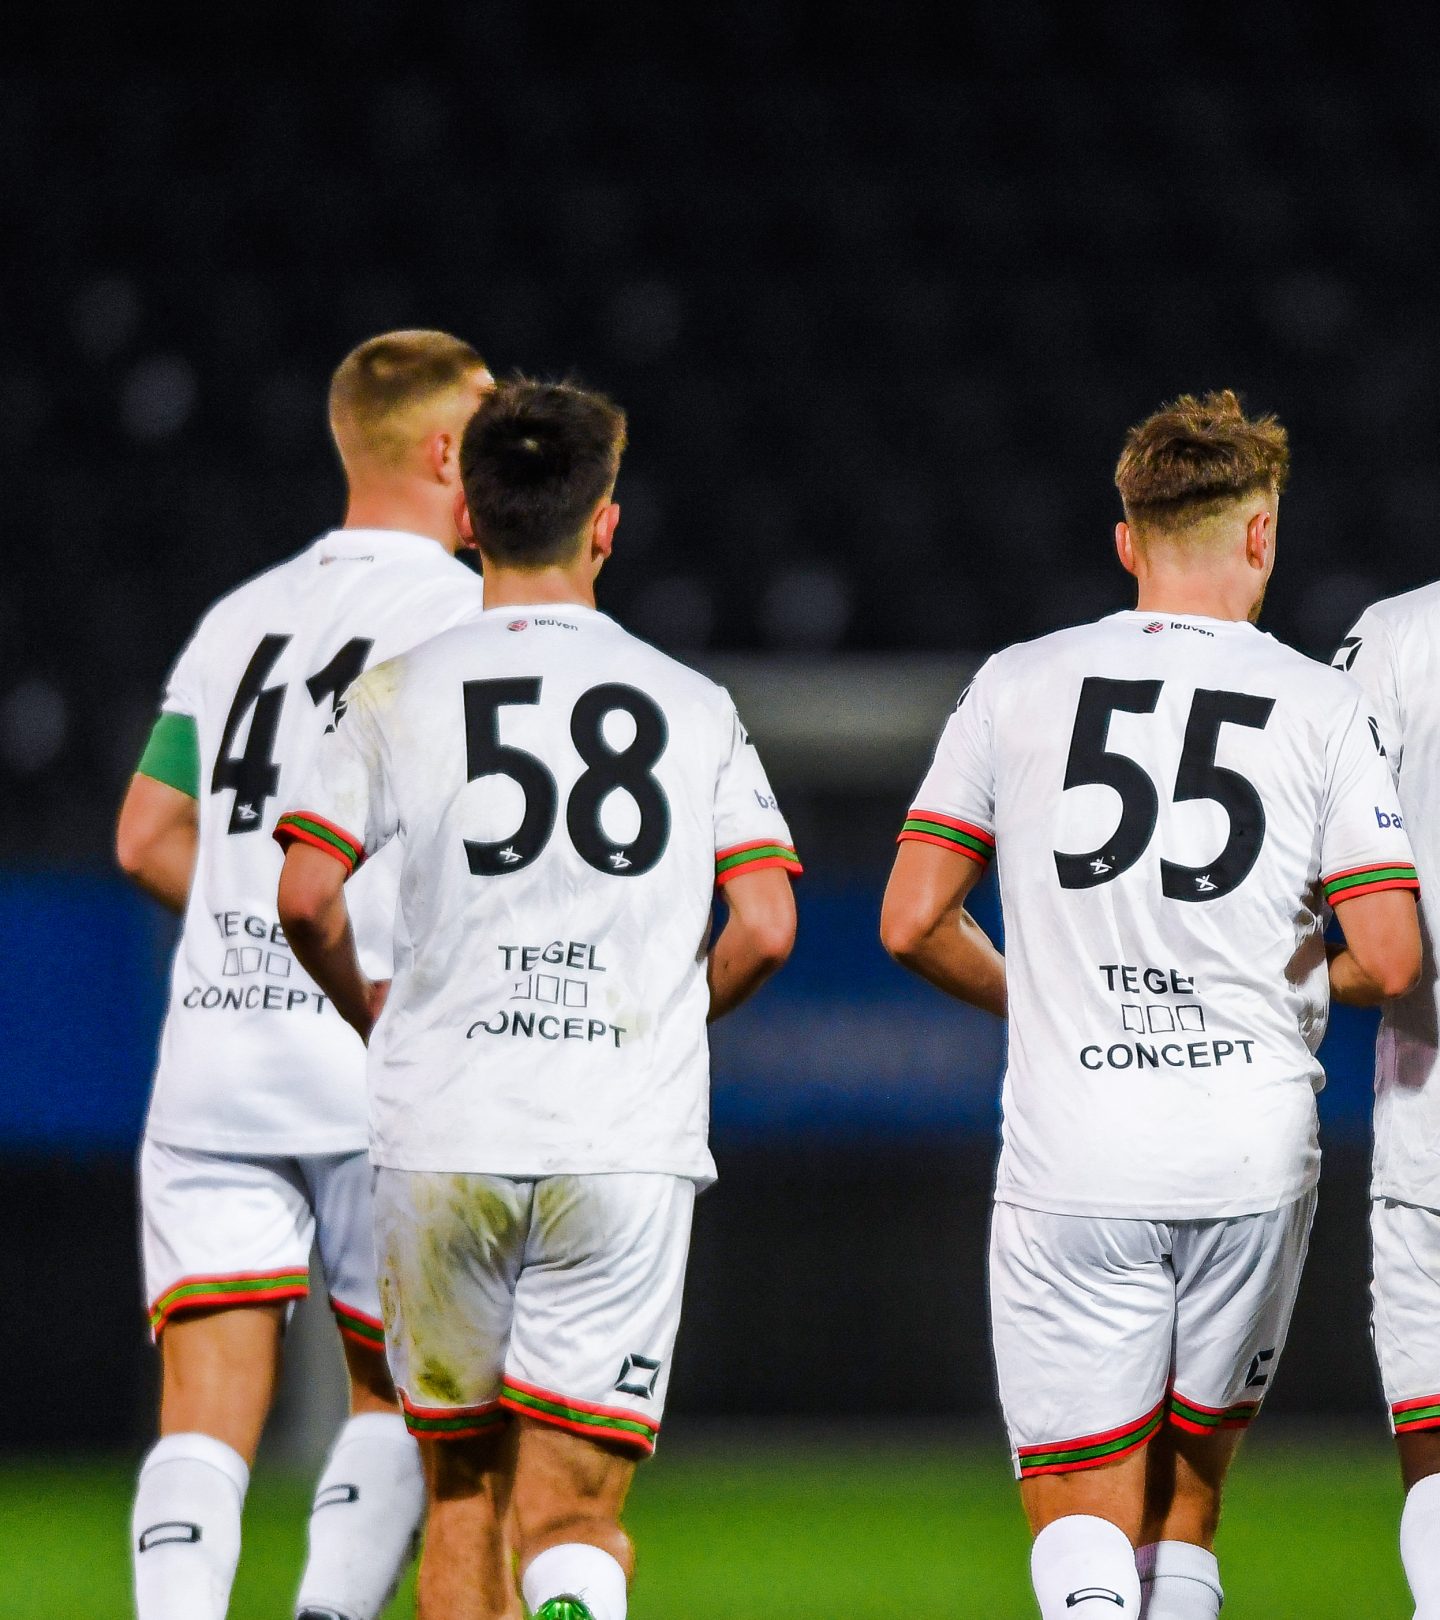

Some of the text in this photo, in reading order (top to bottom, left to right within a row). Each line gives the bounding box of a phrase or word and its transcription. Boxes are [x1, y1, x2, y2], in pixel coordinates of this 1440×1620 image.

[534, 618, 579, 632] leuven
[1170, 621, 1215, 638] leuven
[462, 675, 672, 878] 58
[1053, 676, 1277, 902] 55
[213, 911, 290, 948] TEGE
[498, 940, 607, 972] TEGEL
[1099, 964, 1201, 995] TEGE
[183, 985, 328, 1014] CONCEPT
[1079, 1040, 1255, 1071] CONCEPT
